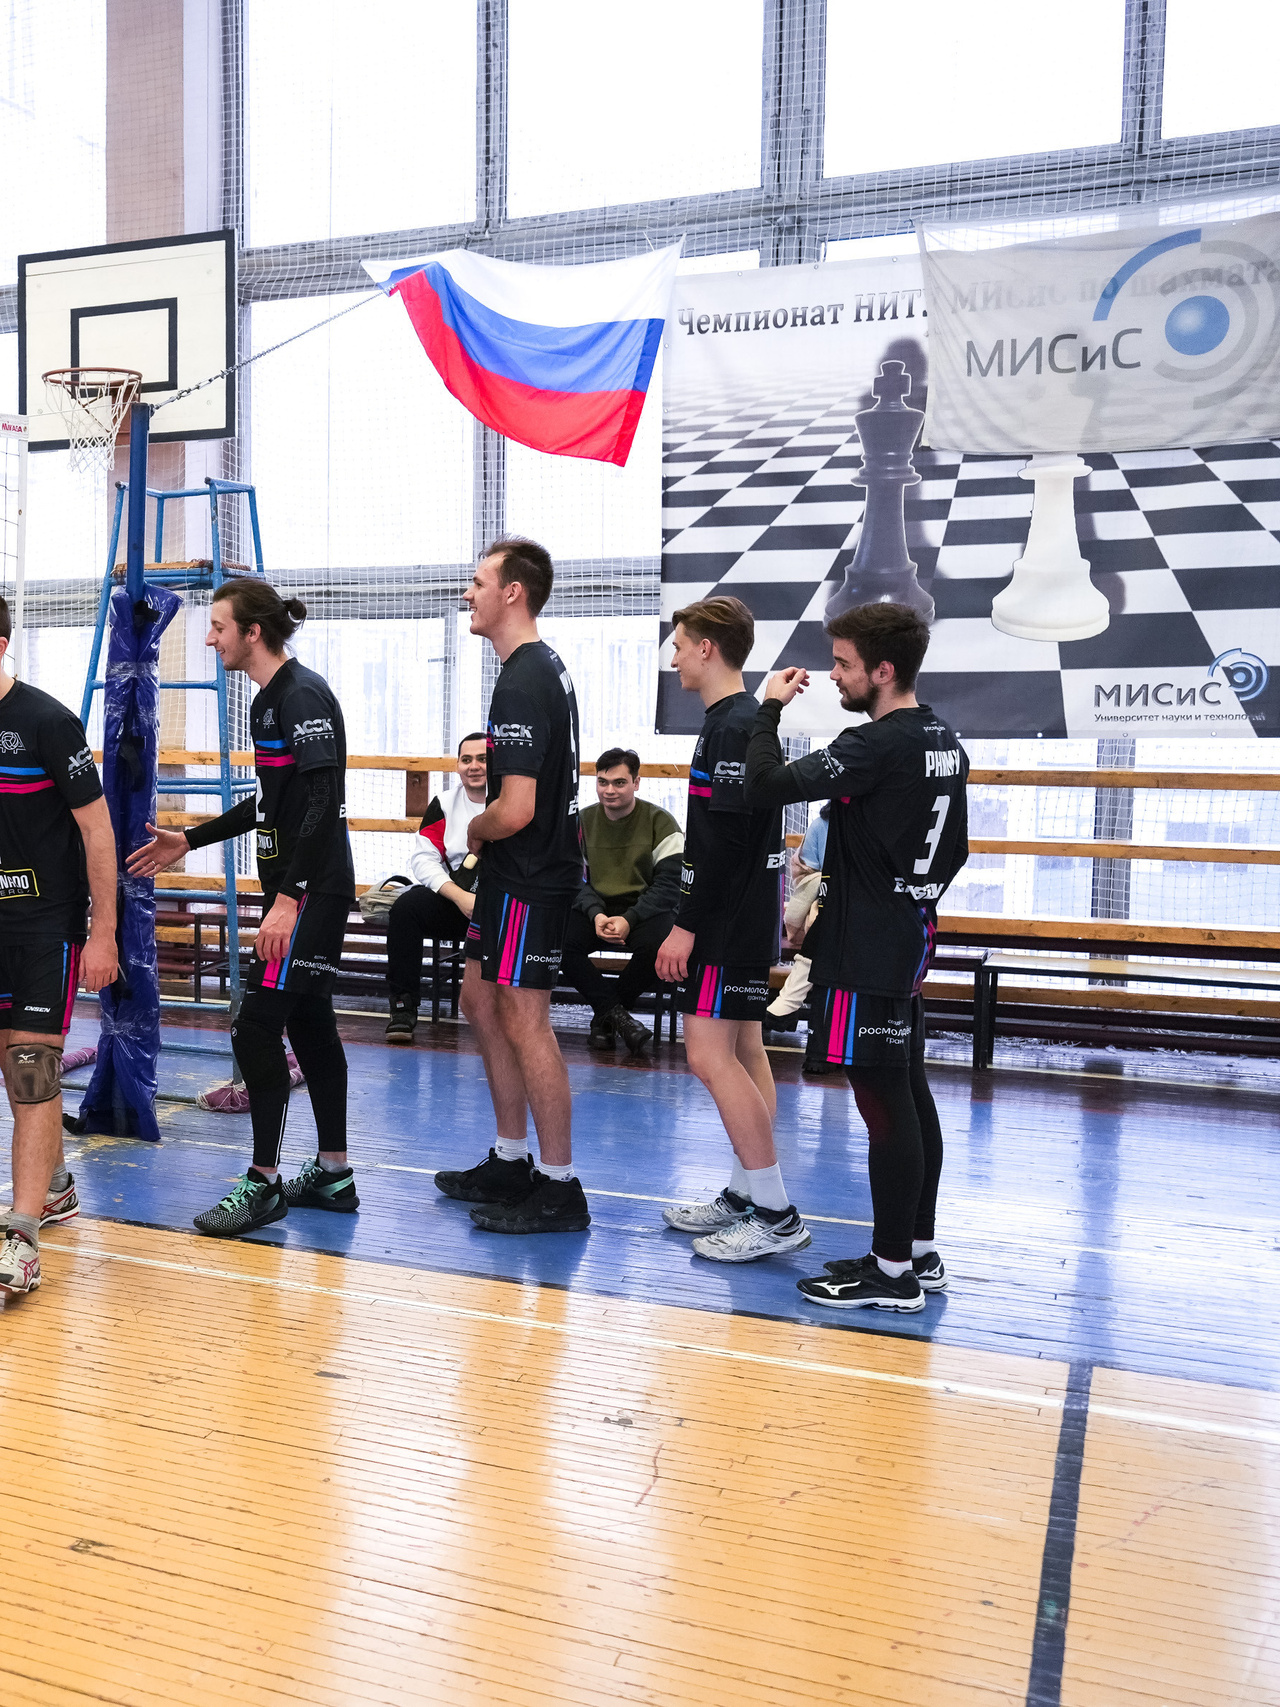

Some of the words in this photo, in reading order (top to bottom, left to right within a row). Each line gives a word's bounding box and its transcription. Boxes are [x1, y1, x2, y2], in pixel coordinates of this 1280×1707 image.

[677, 304, 844, 335] Чемпионат
[854, 289, 927, 322] НИТ
[966, 328, 1143, 377] МИСиС
[1094, 682, 1222, 708] МИСиС
[1094, 714, 1159, 723] Университет
[1162, 714, 1191, 723] науки
[1204, 713, 1266, 722] технолоий
[913, 795, 950, 875] 3
